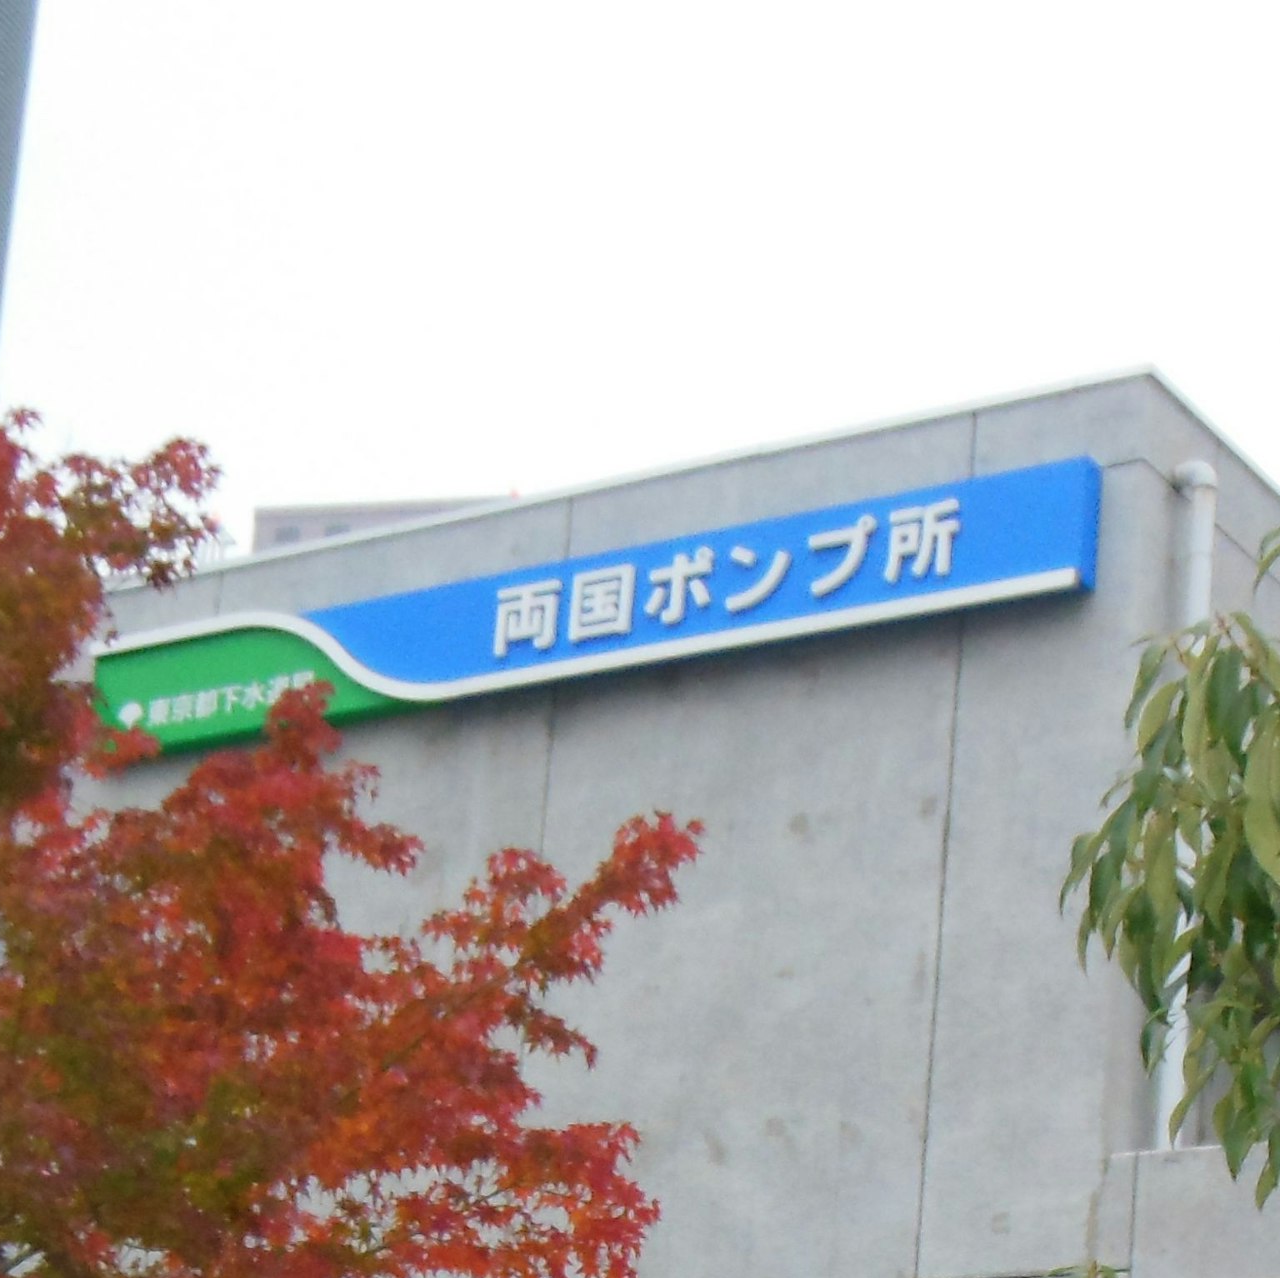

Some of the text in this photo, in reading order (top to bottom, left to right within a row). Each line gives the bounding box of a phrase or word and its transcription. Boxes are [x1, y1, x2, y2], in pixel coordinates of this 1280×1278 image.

[493, 498, 961, 658] 両国ポンプ所
